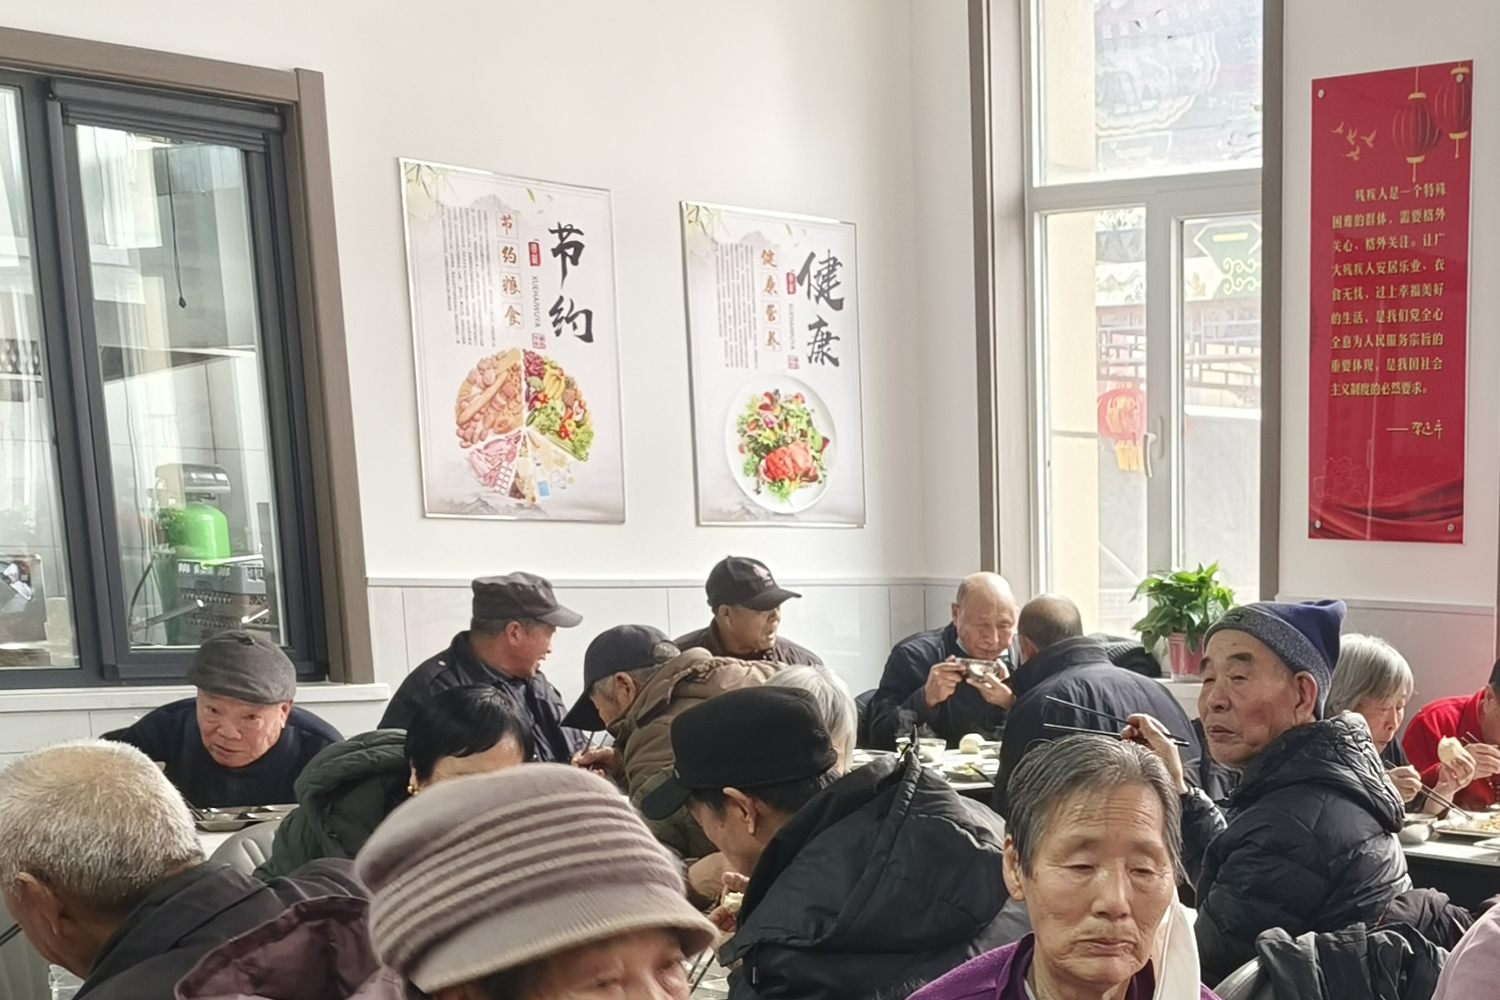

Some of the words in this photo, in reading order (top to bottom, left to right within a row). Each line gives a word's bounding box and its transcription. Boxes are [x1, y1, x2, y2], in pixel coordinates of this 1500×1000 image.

[1355, 182, 1447, 202] 残疾人是一个特殊
[500, 214, 521, 326] 节约粮食
[548, 221, 594, 343] 节约
[797, 249, 845, 367] 健康
[1331, 332, 1444, 350] 全意为人民服务宗旨的
